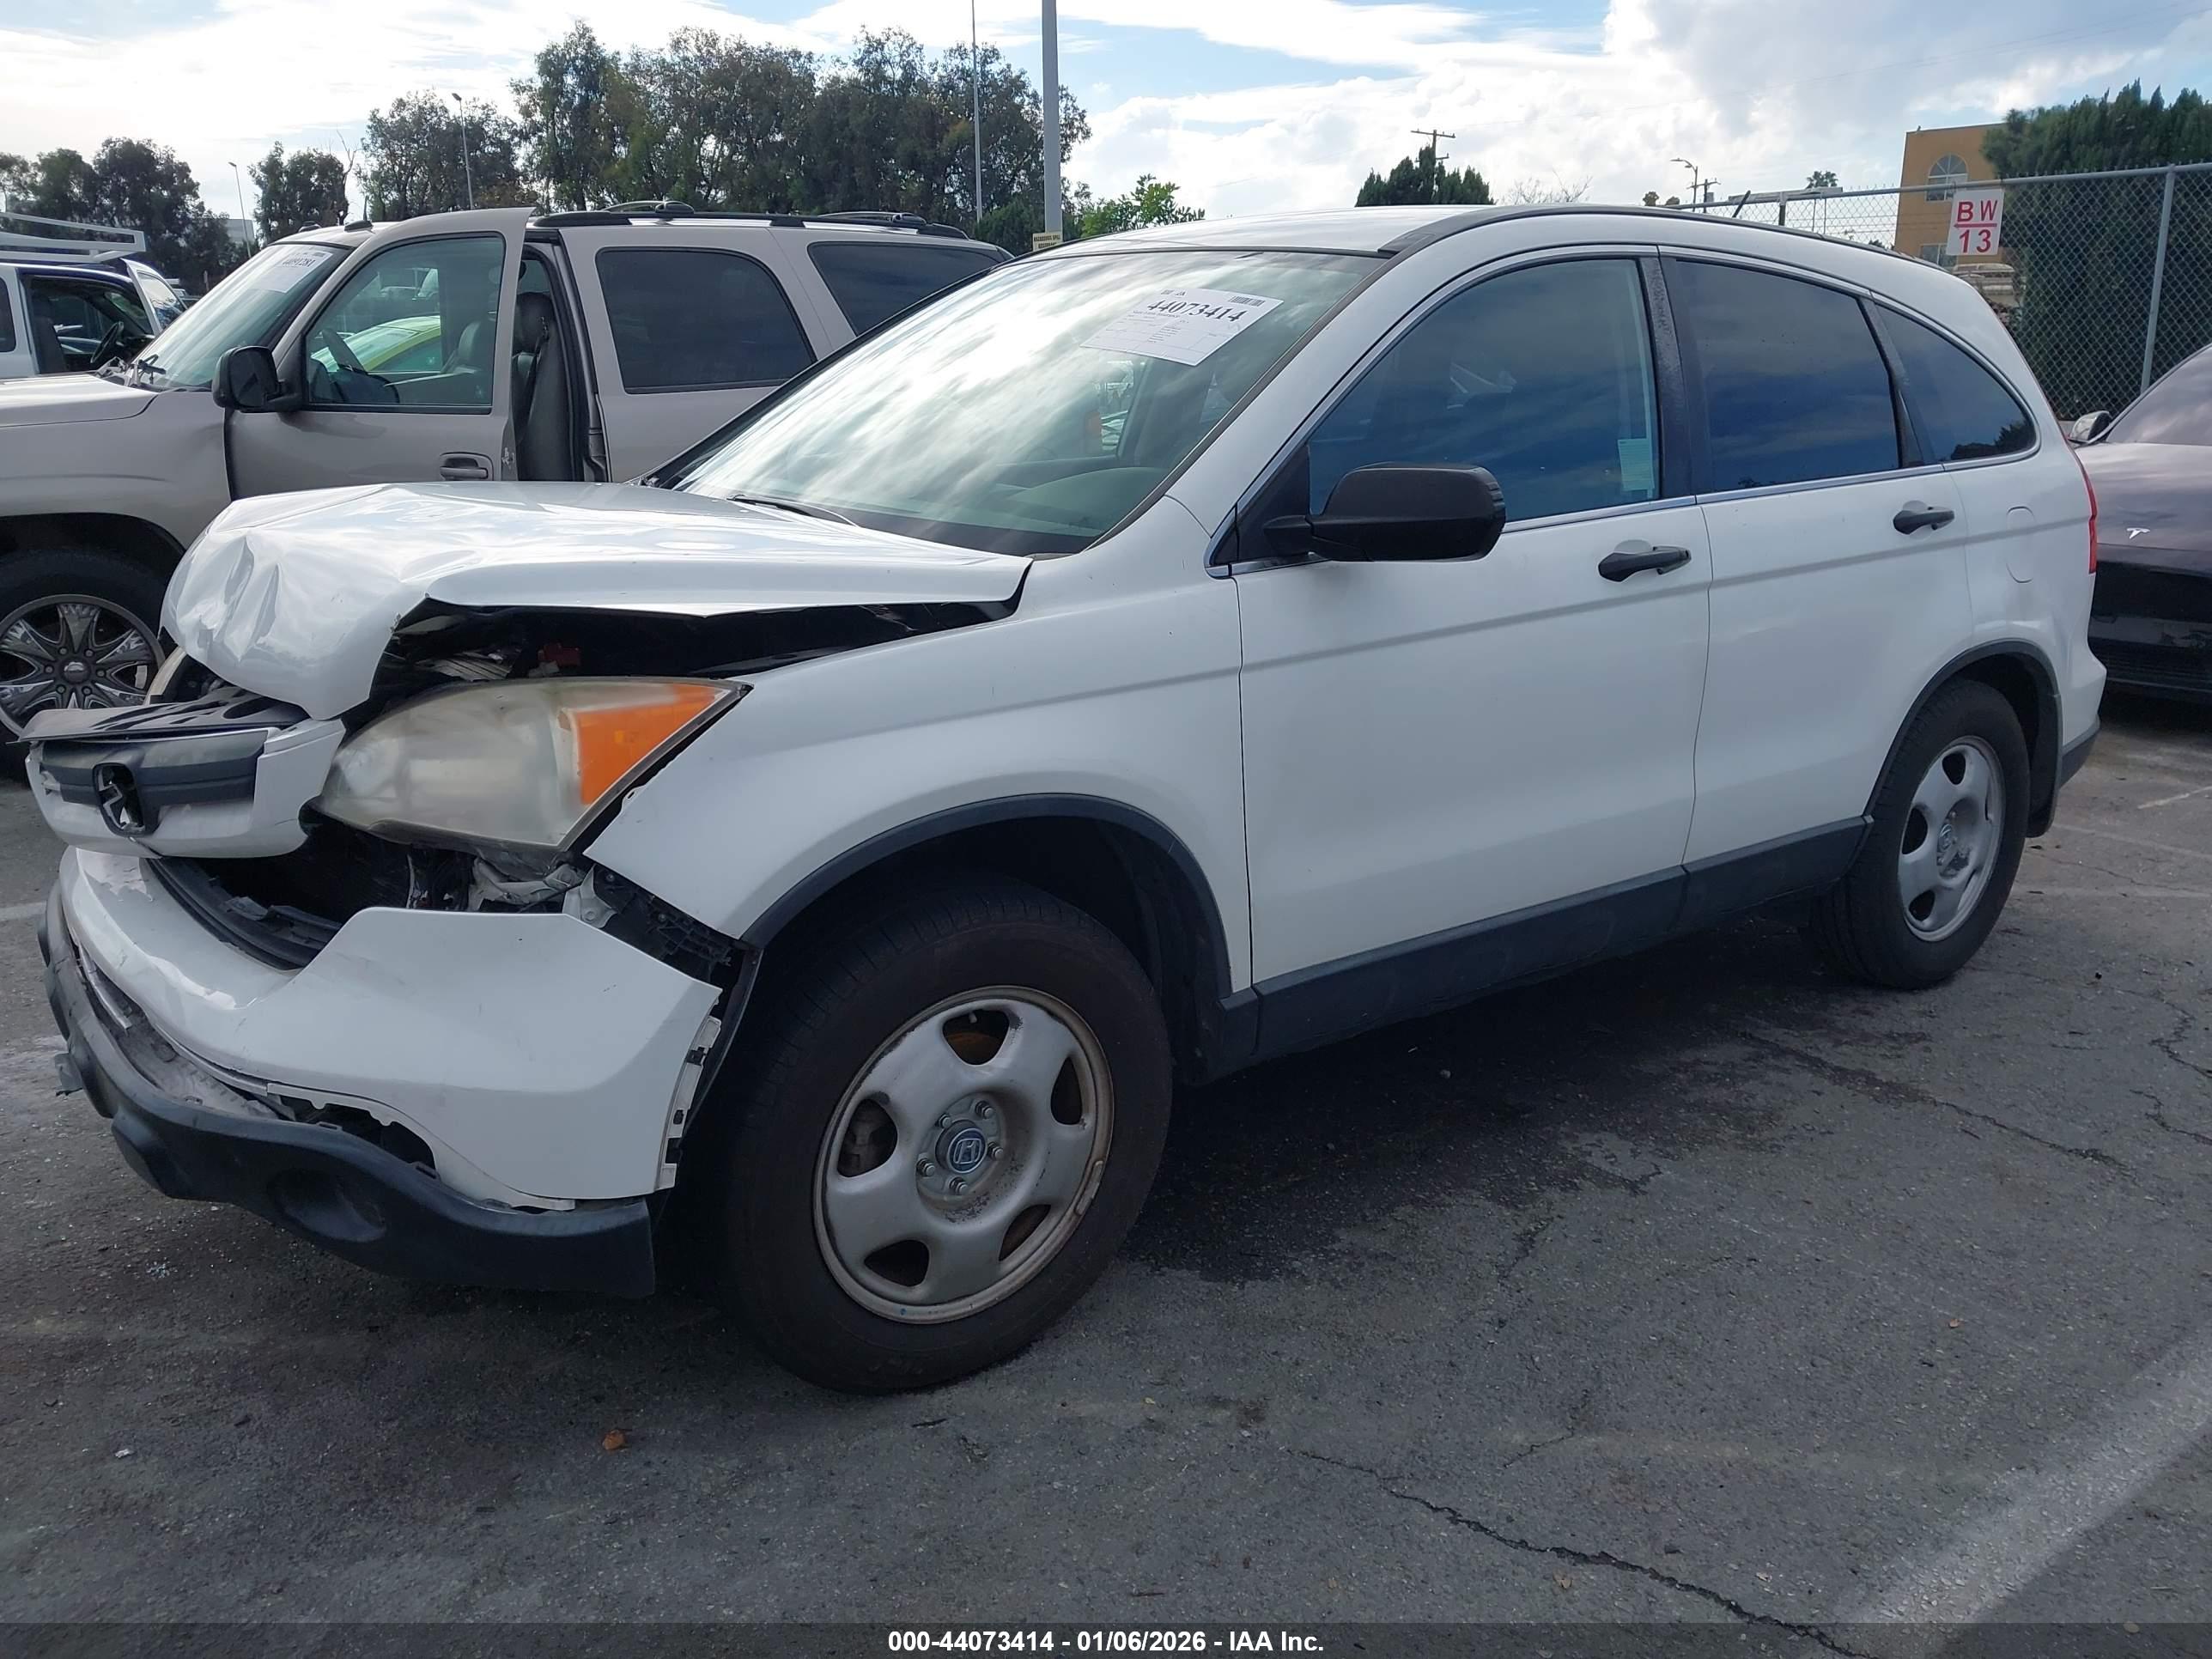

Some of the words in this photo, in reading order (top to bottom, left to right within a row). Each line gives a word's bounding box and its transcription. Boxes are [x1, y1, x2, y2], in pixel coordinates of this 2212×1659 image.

[1957, 199, 1998, 222] BW
[1959, 228, 1992, 253] 13
[1147, 299, 1248, 322] 44073414
